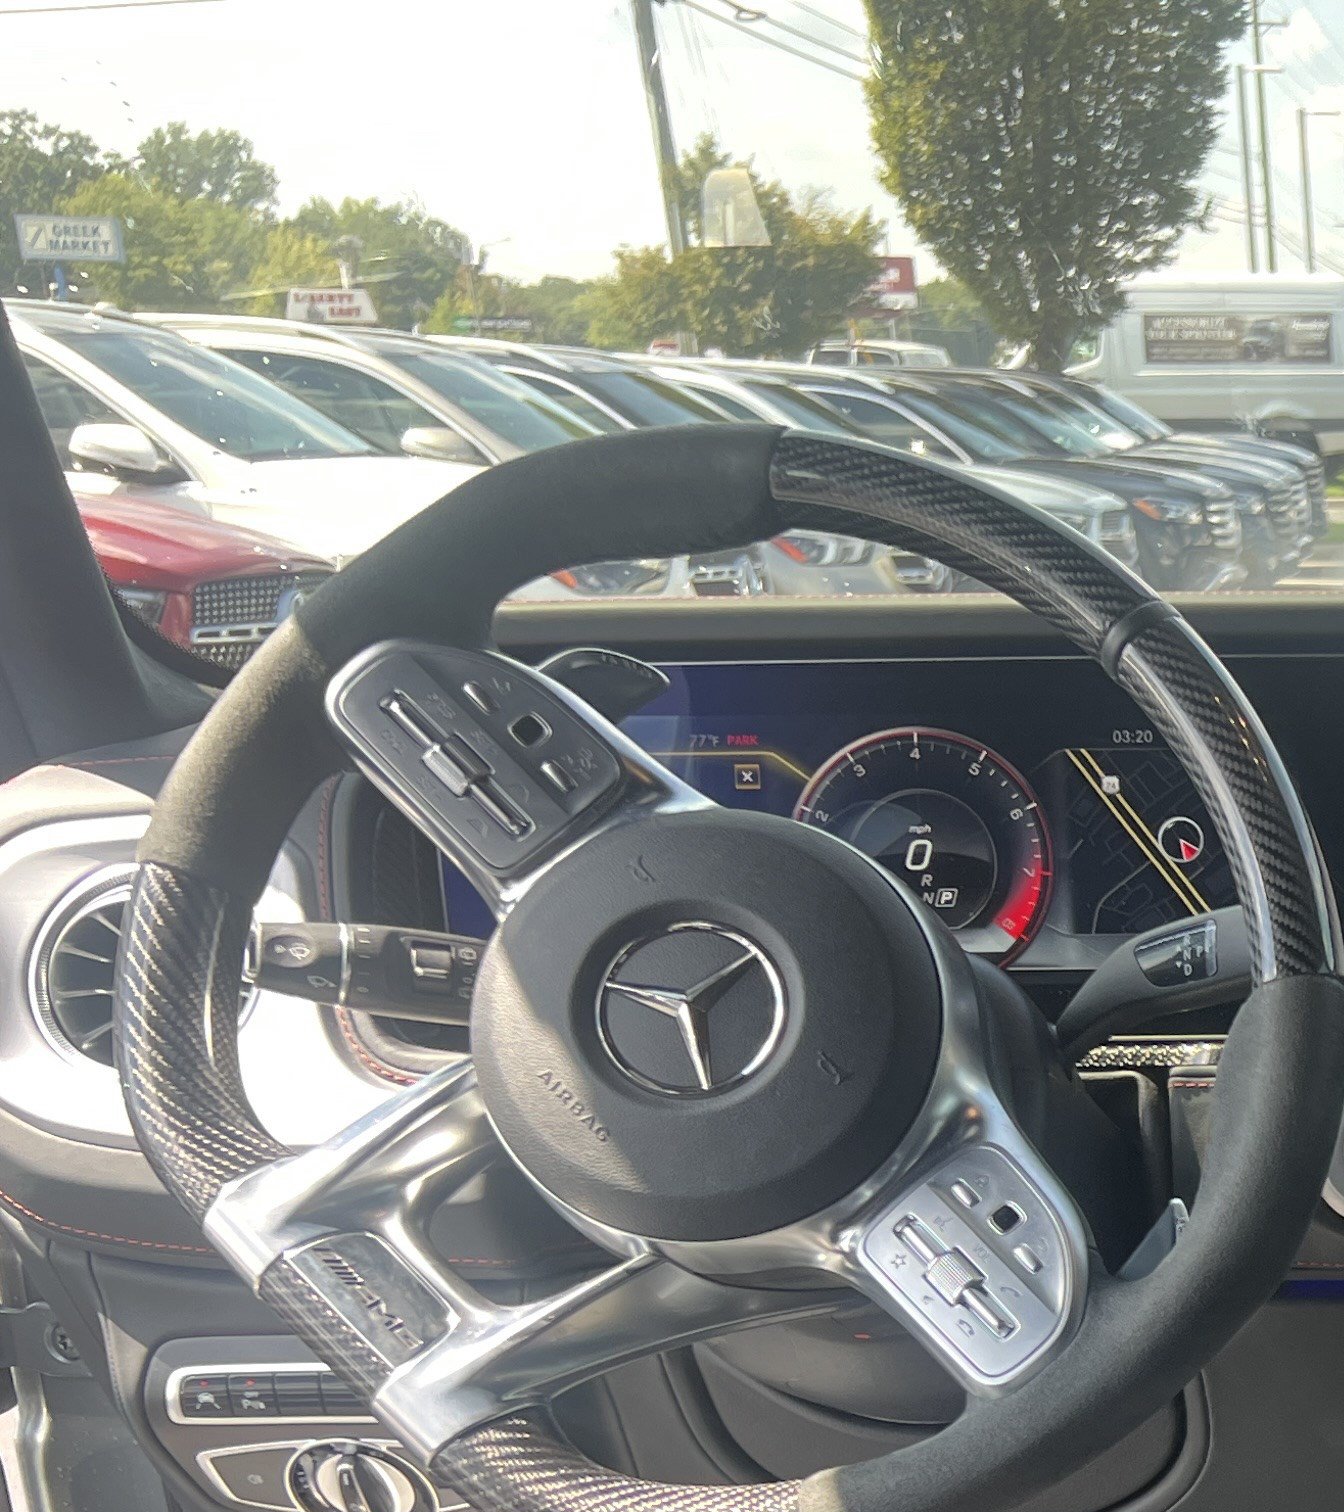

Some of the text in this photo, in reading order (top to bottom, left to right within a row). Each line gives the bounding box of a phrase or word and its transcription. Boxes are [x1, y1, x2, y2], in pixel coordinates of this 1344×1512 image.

[727, 734, 759, 746] PARK
[1113, 730, 1153, 744] 03:20
[910, 748, 921, 760] 4
[854, 764, 866, 777] 3
[968, 763, 981, 777] 5
[815, 809, 829, 821] 2
[1010, 807, 1023, 821] 6
[909, 824, 932, 835] mph
[905, 839, 933, 871] 0
[921, 875, 933, 887] R
[922, 892, 953, 905] N P
[1183, 947, 1192, 960] N
[1183, 963, 1193, 976] D
[536, 1070, 611, 1142] AIRBAG
